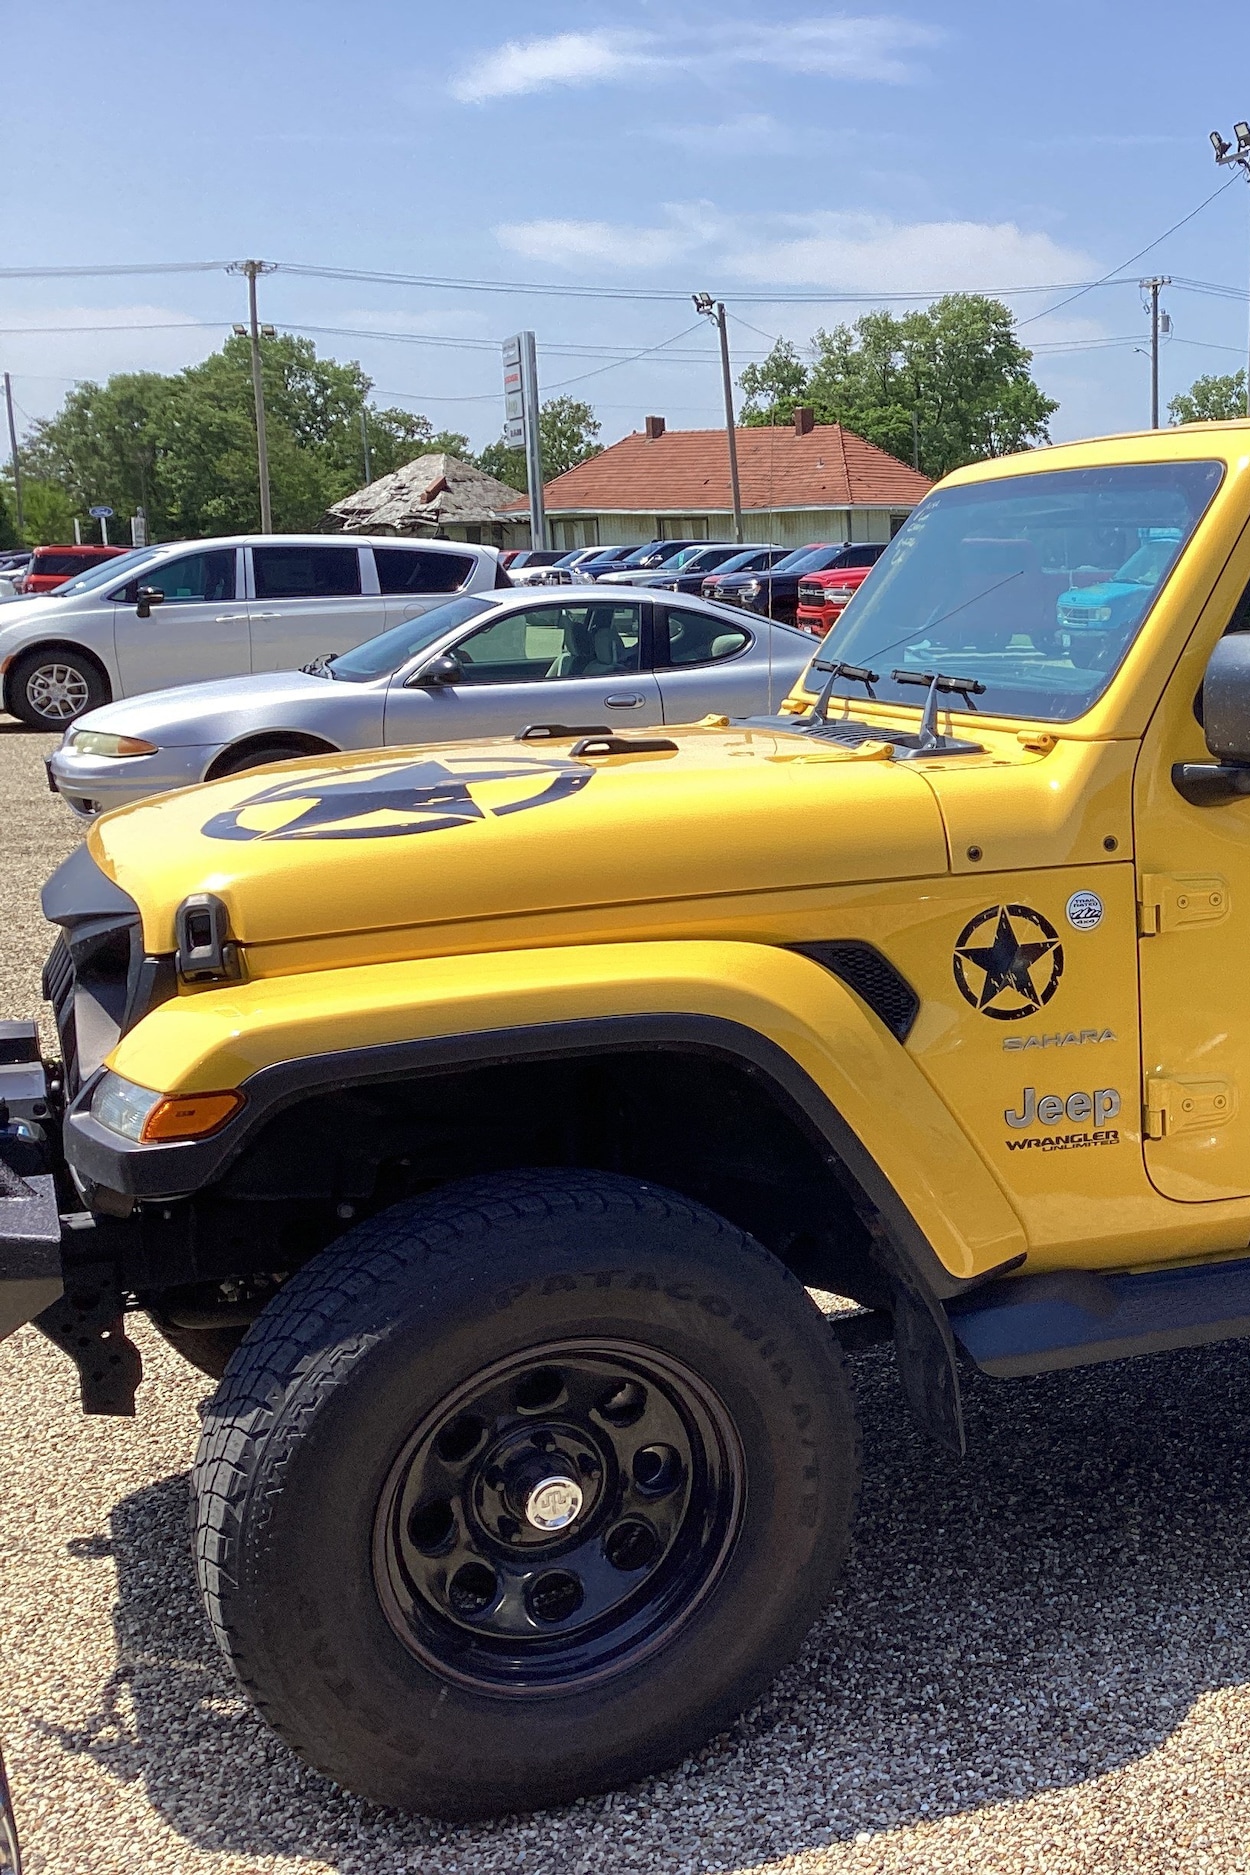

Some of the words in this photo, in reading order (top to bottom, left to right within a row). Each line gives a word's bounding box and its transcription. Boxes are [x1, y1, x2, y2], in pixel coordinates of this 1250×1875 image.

[1002, 1027, 1117, 1052] SAHARA
[1004, 1087, 1121, 1129] Jeep
[1005, 1130, 1120, 1151] WRANGLER
[1042, 1139, 1120, 1152] UNLIMITED
